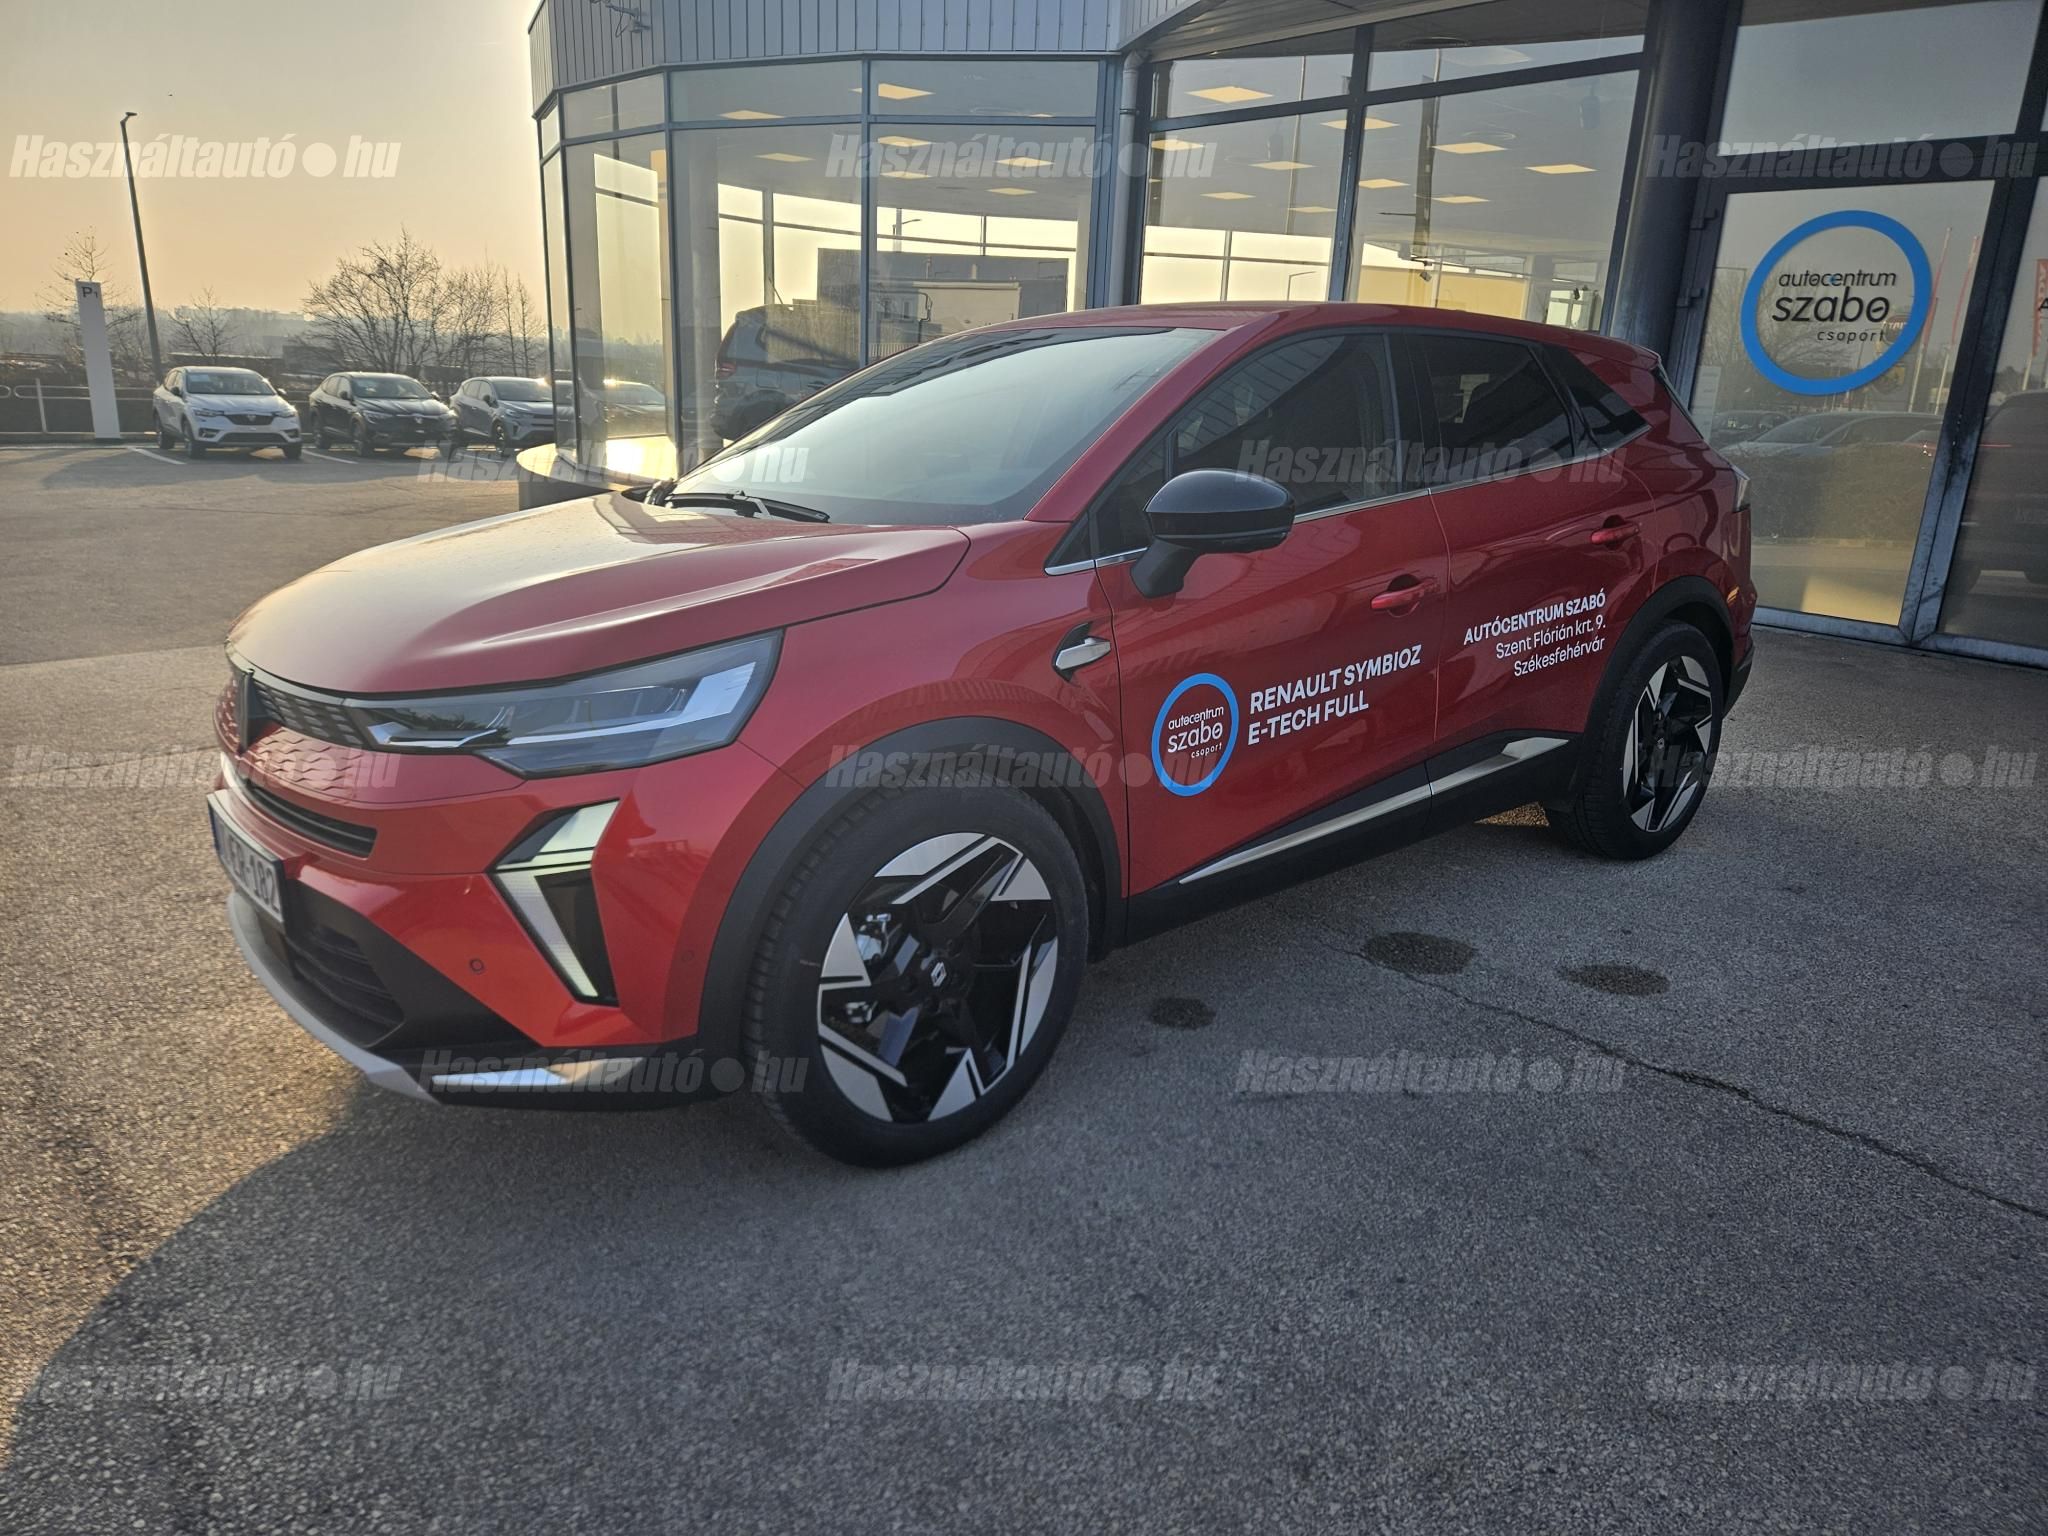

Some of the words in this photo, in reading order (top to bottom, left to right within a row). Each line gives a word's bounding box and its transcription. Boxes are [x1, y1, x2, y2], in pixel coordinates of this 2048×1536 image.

[1816, 329, 1885, 344] csoport
[1464, 602, 1564, 645] AUTÓCENTRUM
[1565, 588, 1606, 617] SZABÓ
[1496, 636, 1532, 659] Szent
[1533, 625, 1574, 648] Flórián
[1575, 617, 1594, 636] krt.
[1595, 614, 1606, 630] 9.
[1250, 668, 1342, 714] RENAULT
[1344, 644, 1422, 686] SYMBIOZ
[1513, 637, 1606, 677] Székesfehérvár
[1247, 703, 1321, 746] E-TECH
[1323, 690, 1369, 722] FULL
